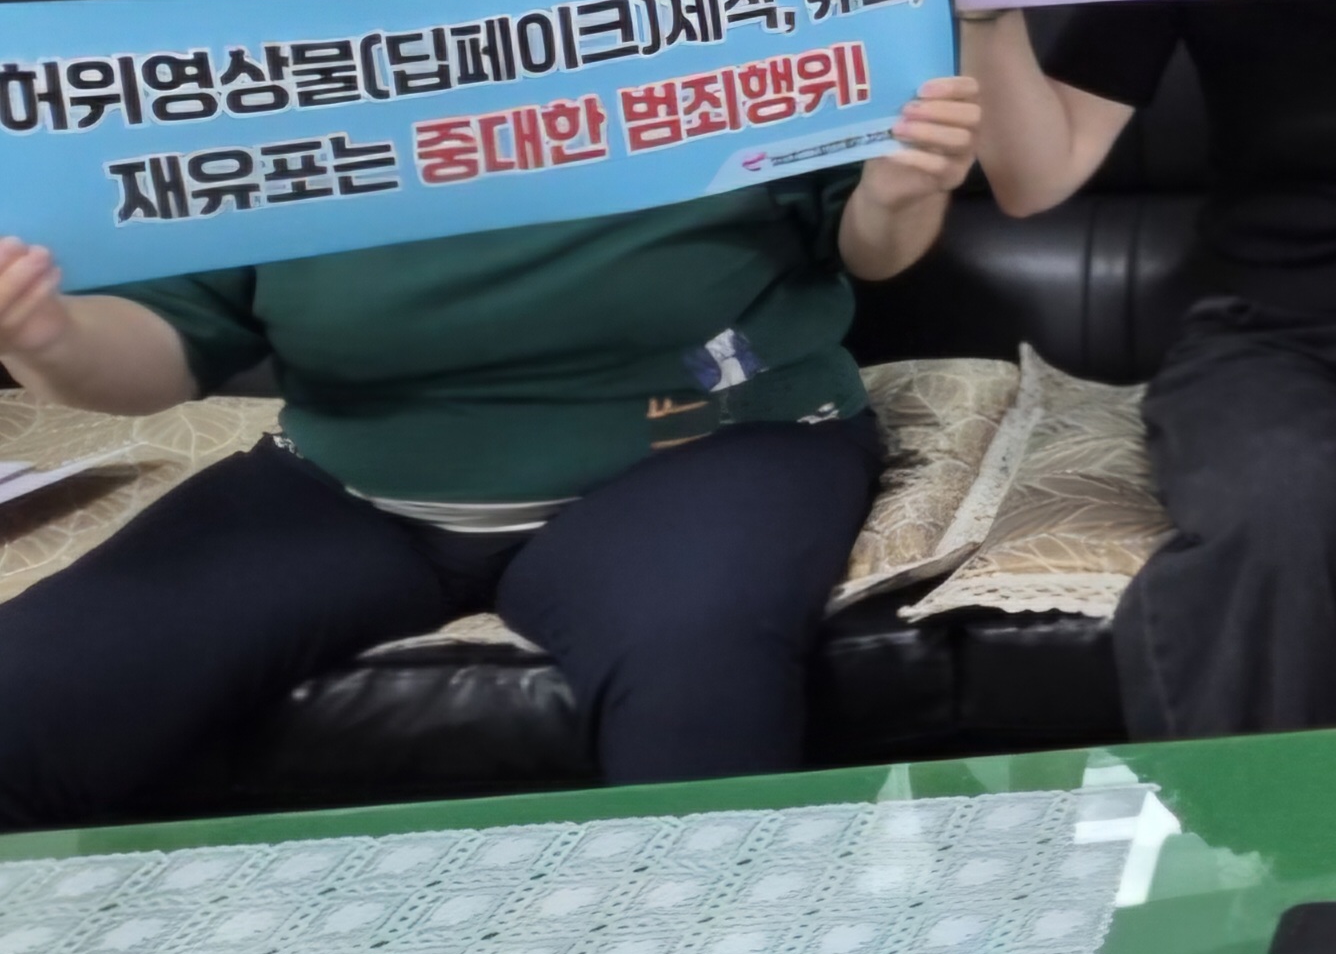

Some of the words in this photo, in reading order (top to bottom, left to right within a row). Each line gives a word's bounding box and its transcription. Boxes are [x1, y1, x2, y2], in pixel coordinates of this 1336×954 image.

[107, 134, 399, 224] 재유포는
[415, 96, 607, 184] 중대한
[621, 43, 870, 153] 범죄행위!
